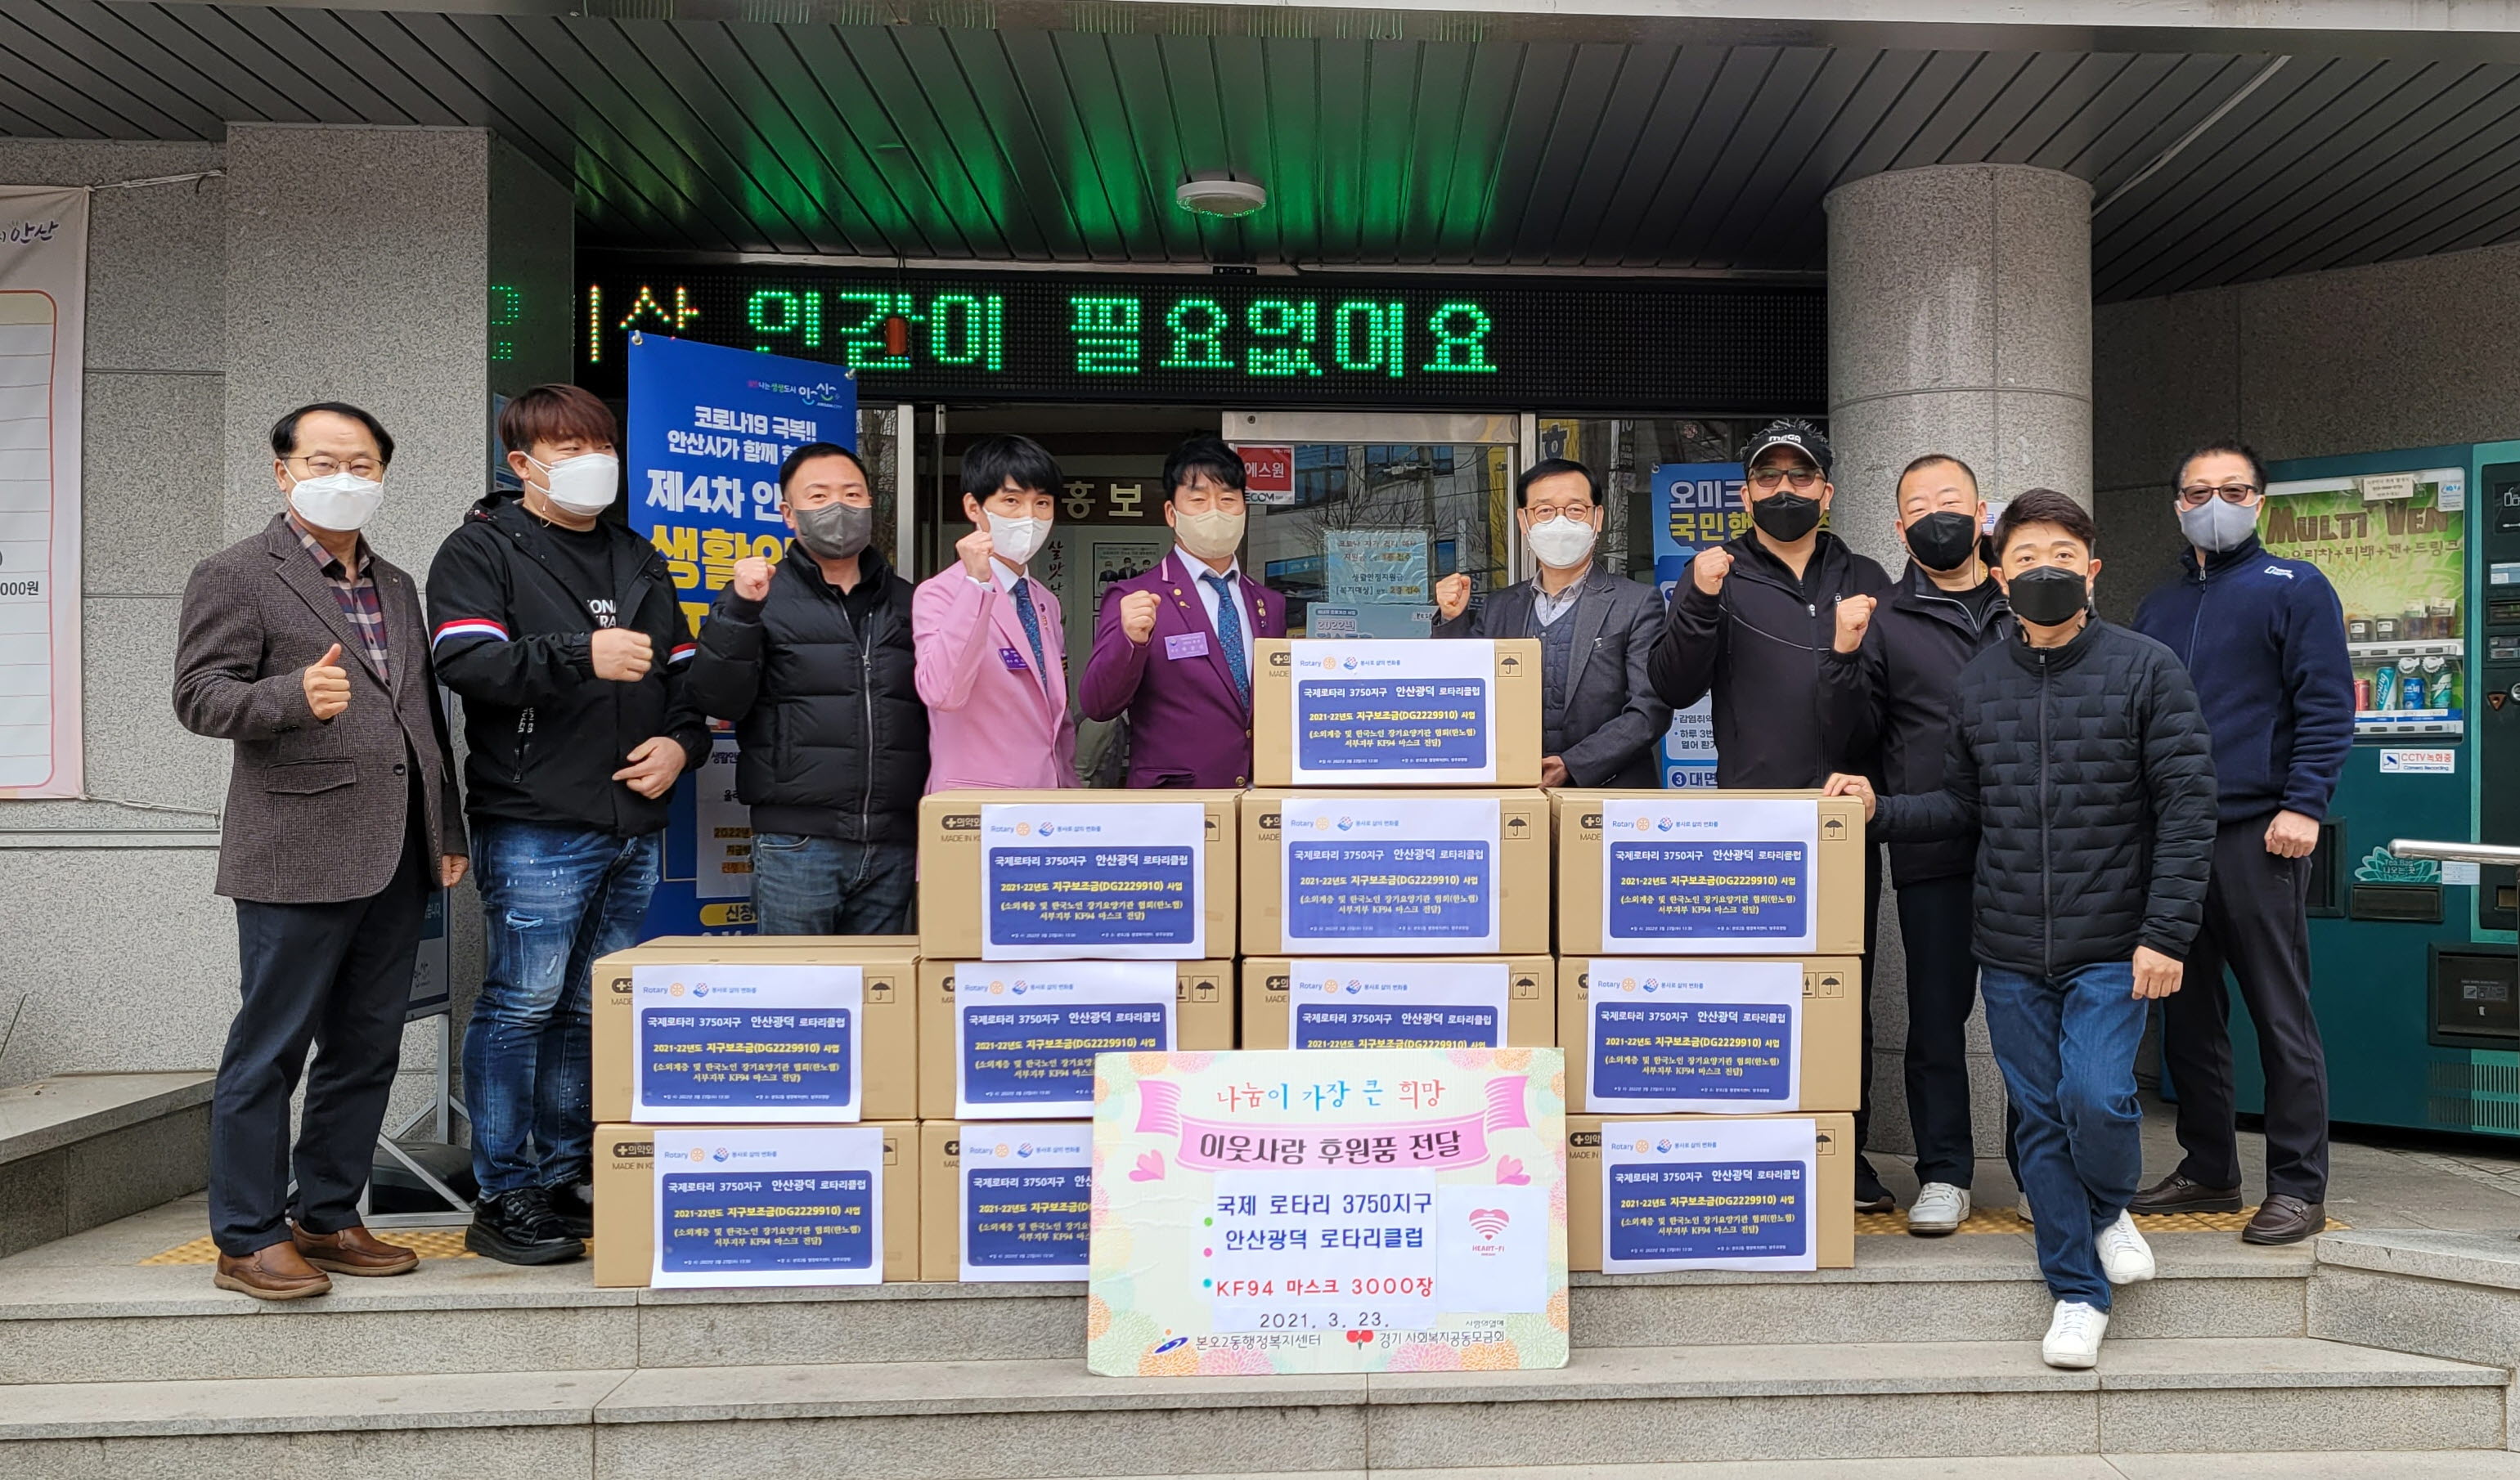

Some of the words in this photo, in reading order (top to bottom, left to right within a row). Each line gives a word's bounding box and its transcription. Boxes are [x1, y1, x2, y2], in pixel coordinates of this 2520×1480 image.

[1070, 296, 1498, 378] 필요없어요
[694, 406, 768, 435] 코로나19
[772, 415, 817, 442] 극복!!
[667, 430, 739, 460] 안산시가
[743, 439, 779, 465] 함께
[1245, 462, 1284, 478] 에스원
[646, 469, 745, 518] 제4차
[1304, 688, 1345, 698] 국제로타리
[1350, 687, 1387, 697] 3750지구
[1396, 685, 1435, 697] 안산광덕
[1439, 686, 1480, 697] 로타리클럽
[1309, 713, 1354, 721] 2021-22년도
[1356, 711, 1458, 721] 지구보조금(DG2229910)
[1462, 711, 1476, 720] 사업
[1680, 729, 1697, 738] 하루
[2401, 753, 2426, 761] CCTV
[992, 825, 1014, 833] Rotary
[1291, 819, 1314, 827] Rotary
[1613, 820, 1634, 828] Rotary
[995, 856, 1040, 867] 국제로타리
[1044, 855, 1087, 867] 3750지구
[1096, 854, 1139, 867] 안산광덕
[1143, 855, 1188, 866] 로타리클럽
[1294, 850, 1340, 861] 국제로타리
[1344, 850, 1385, 860] 3750지구
[1394, 848, 1435, 860] 안산광덕
[1440, 850, 1484, 860] 로타리클럽
[1615, 850, 1660, 861] 국제로타리
[1664, 850, 1704, 861] 3750지구
[1713, 849, 1754, 861] 안산광덕
[1759, 850, 1801, 861] 로타리클럽
[1001, 883, 1049, 892] 2021-22년도
[1053, 881, 1163, 892] 지구보조금(DG2229910)
[1167, 881, 1183, 891] 사업
[1300, 877, 1347, 886] 2021-22년도
[1350, 875, 1459, 886] 지구보조금(DG2229910)
[1463, 876, 1478, 885] 사업
[1621, 877, 1667, 886] 2021-22년도
[1670, 876, 1777, 886] 지구보조금(DG2229910)
[1781, 877, 1796, 886] 사업
[1599, 980, 1620, 989] Rotary
[1601, 1011, 1645, 1022] 국제로타리
[1648, 1011, 1689, 1022] 3750지구
[1697, 1011, 1738, 1023] 안산광덕
[1743, 1012, 1786, 1024] 로타리클럽
[1606, 1038, 1652, 1047] 2021-22년도
[1655, 1037, 1762, 1048] 지구보조금(DG2229910)
[1765, 1039, 1780, 1048] 사업
[1217, 1082, 1288, 1112] 나눔이
[1302, 1080, 1350, 1111] 가장
[1363, 1079, 1384, 1106] 큰
[1399, 1079, 1446, 1110] 희망
[1200, 1133, 1307, 1164] 이웃사랑
[1318, 1136, 1398, 1164] 후원품
[1408, 1130, 1462, 1159] 전달
[1612, 1142, 1633, 1151] Rotary
[665, 1151, 688, 1159] Rotary
[1615, 1172, 1659, 1184] 국제로타리
[1663, 1171, 1703, 1182] 3750지구
[1712, 1169, 1753, 1182] 안산광덕
[1757, 1169, 1800, 1181] 로타리클럽
[668, 1182, 715, 1193] 국제로타리
[719, 1181, 762, 1192] 3750지구
[771, 1179, 815, 1191] 안산광덕
[820, 1179, 866, 1191] 로타리클럽
[1216, 1195, 1257, 1217] 국제
[1269, 1194, 1331, 1215] 로타리
[1342, 1193, 1432, 1214] 3750지구
[1621, 1199, 1667, 1208] 2021-22년도
[1670, 1195, 1777, 1208] 지구보조금(DG2229910)
[1780, 1195, 1795, 1204] 사업
[674, 1209, 724, 1218] 2021-22년도
[727, 1205, 841, 1218] 지구보조금(DG2229910)
[845, 1206, 860, 1216] 사업
[1226, 1228, 1307, 1251] 안산광덕
[1320, 1227, 1423, 1249] 로타리클럽
[1216, 1280, 1274, 1297] KF94
[1287, 1279, 1340, 1297] 마스크
[1351, 1276, 1433, 1298] 3000장
[1359, 1312, 1390, 1328] 23.
[1195, 1334, 1322, 1352] 본오2동행정복지센터
[1380, 1332, 1402, 1346] 경기
[1405, 1330, 1505, 1347] 사회복지공동모금회
